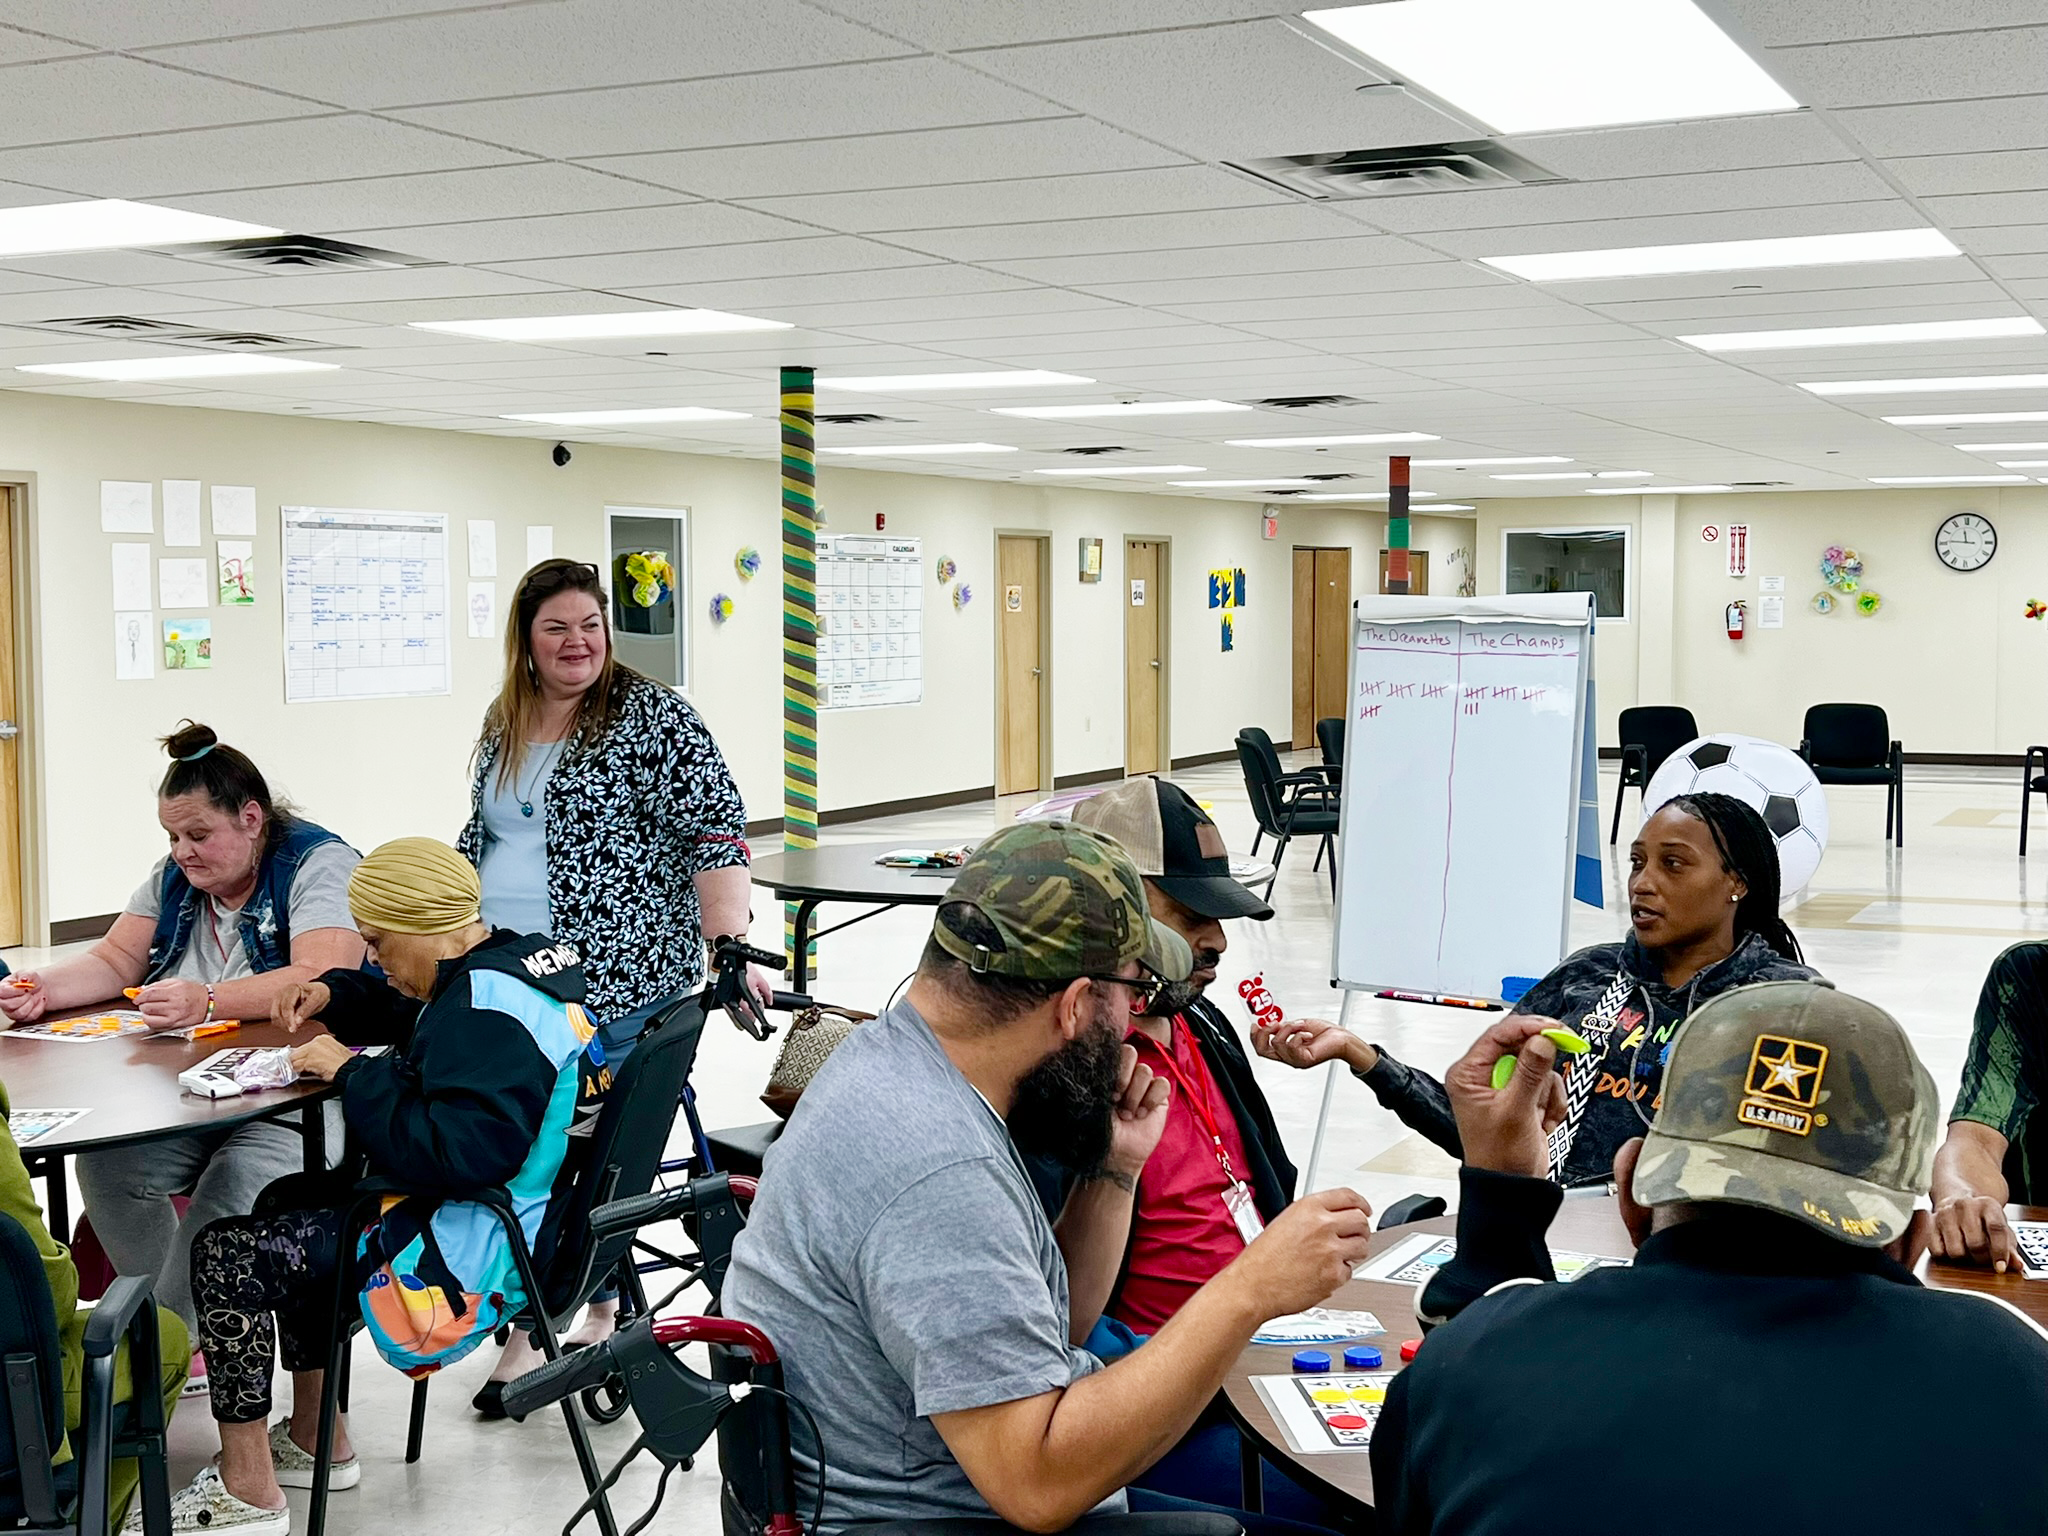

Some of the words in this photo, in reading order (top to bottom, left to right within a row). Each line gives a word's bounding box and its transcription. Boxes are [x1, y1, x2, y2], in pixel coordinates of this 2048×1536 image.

[1362, 628, 1386, 641] The
[1465, 632, 1498, 648] The
[1250, 990, 1273, 1012] 25
[1803, 1200, 1836, 1227] U.S.
